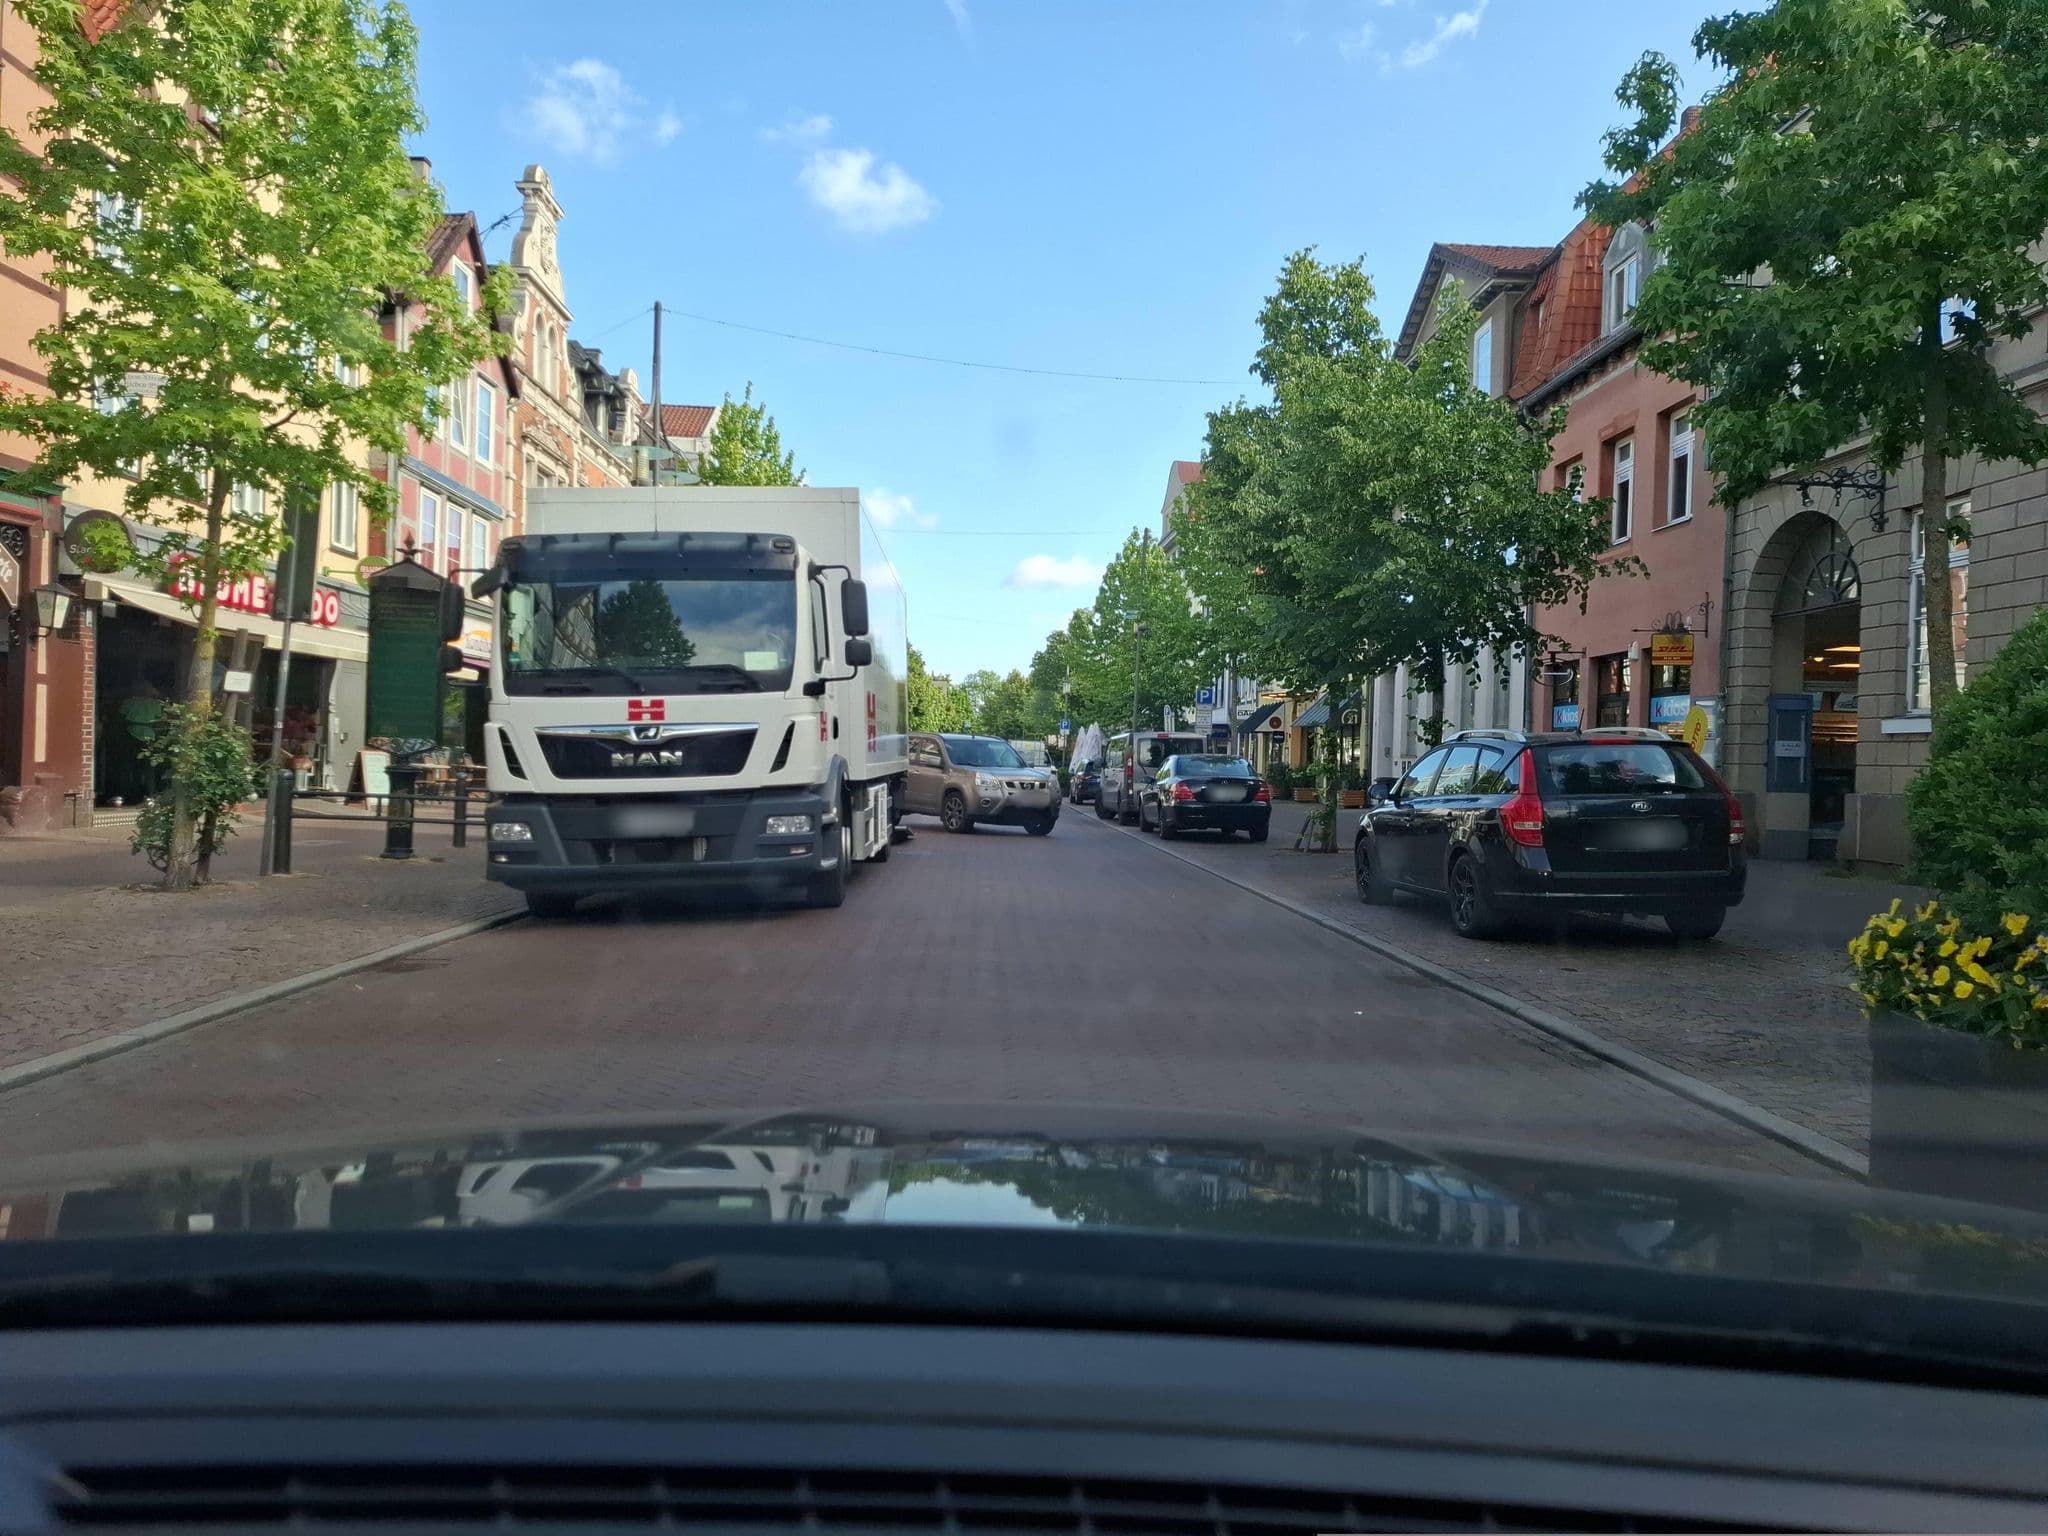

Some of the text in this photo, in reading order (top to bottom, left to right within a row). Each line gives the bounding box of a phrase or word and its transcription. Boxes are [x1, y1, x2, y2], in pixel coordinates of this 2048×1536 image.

[1658, 645, 1688, 653] DHL
[1200, 690, 1209, 702] P
[611, 751, 683, 768] MAN
